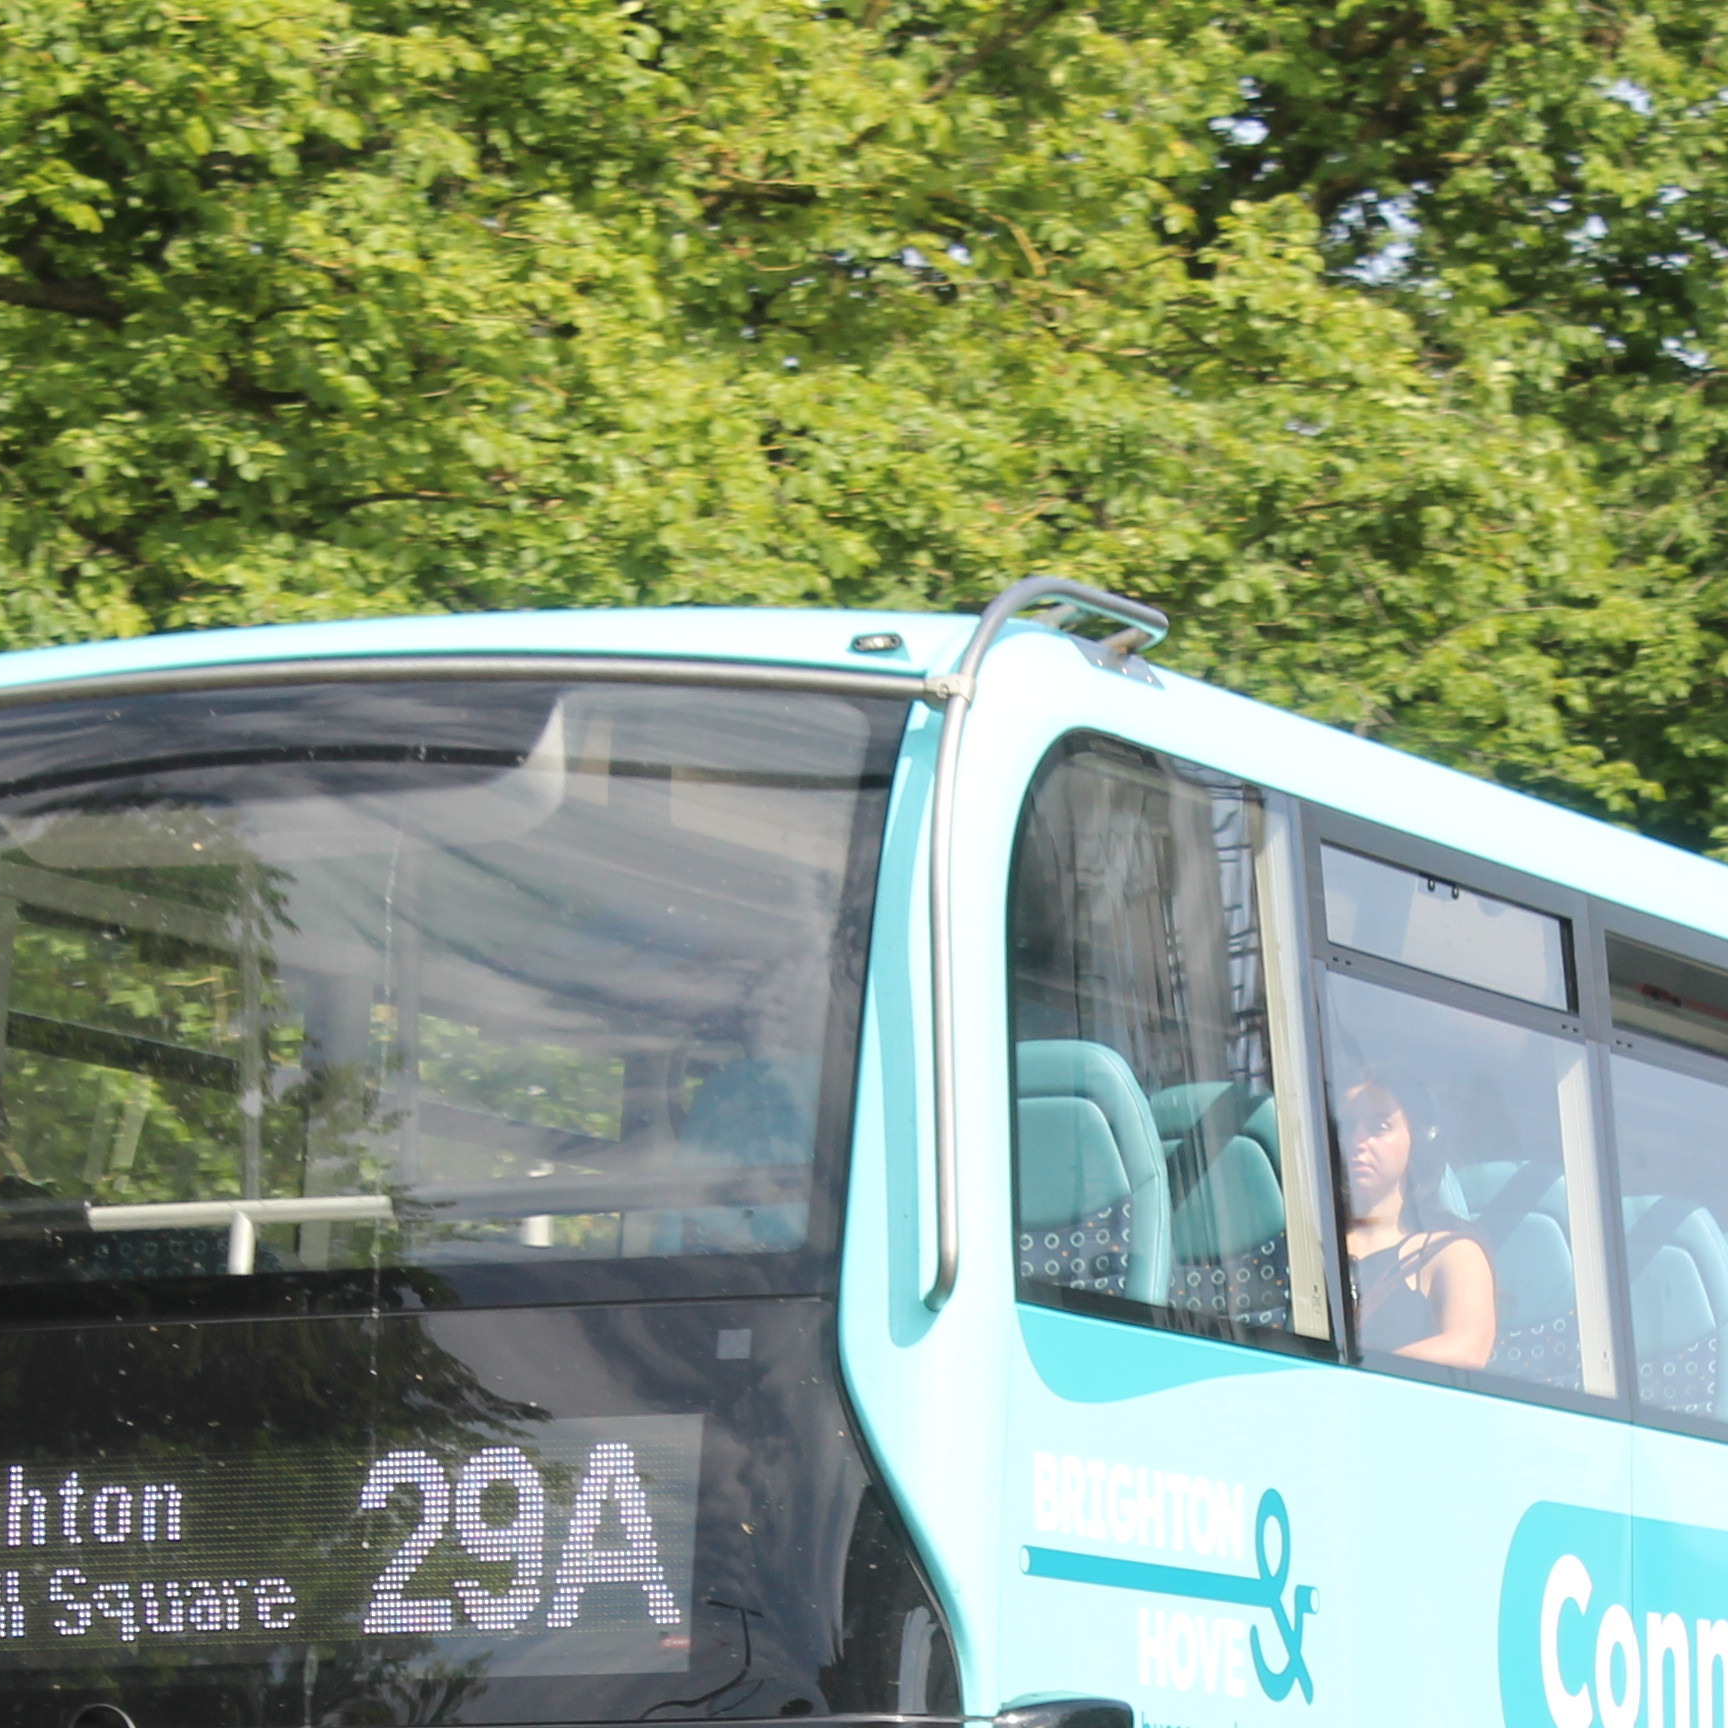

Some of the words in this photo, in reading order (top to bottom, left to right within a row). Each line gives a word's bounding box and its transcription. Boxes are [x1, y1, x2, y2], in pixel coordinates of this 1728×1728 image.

[360, 1441, 682, 1634] 29A
[1032, 1450, 1246, 1561] BRIGHTON
[48, 1567, 298, 1643] Square
[1137, 1607, 1248, 1698] HOVE
